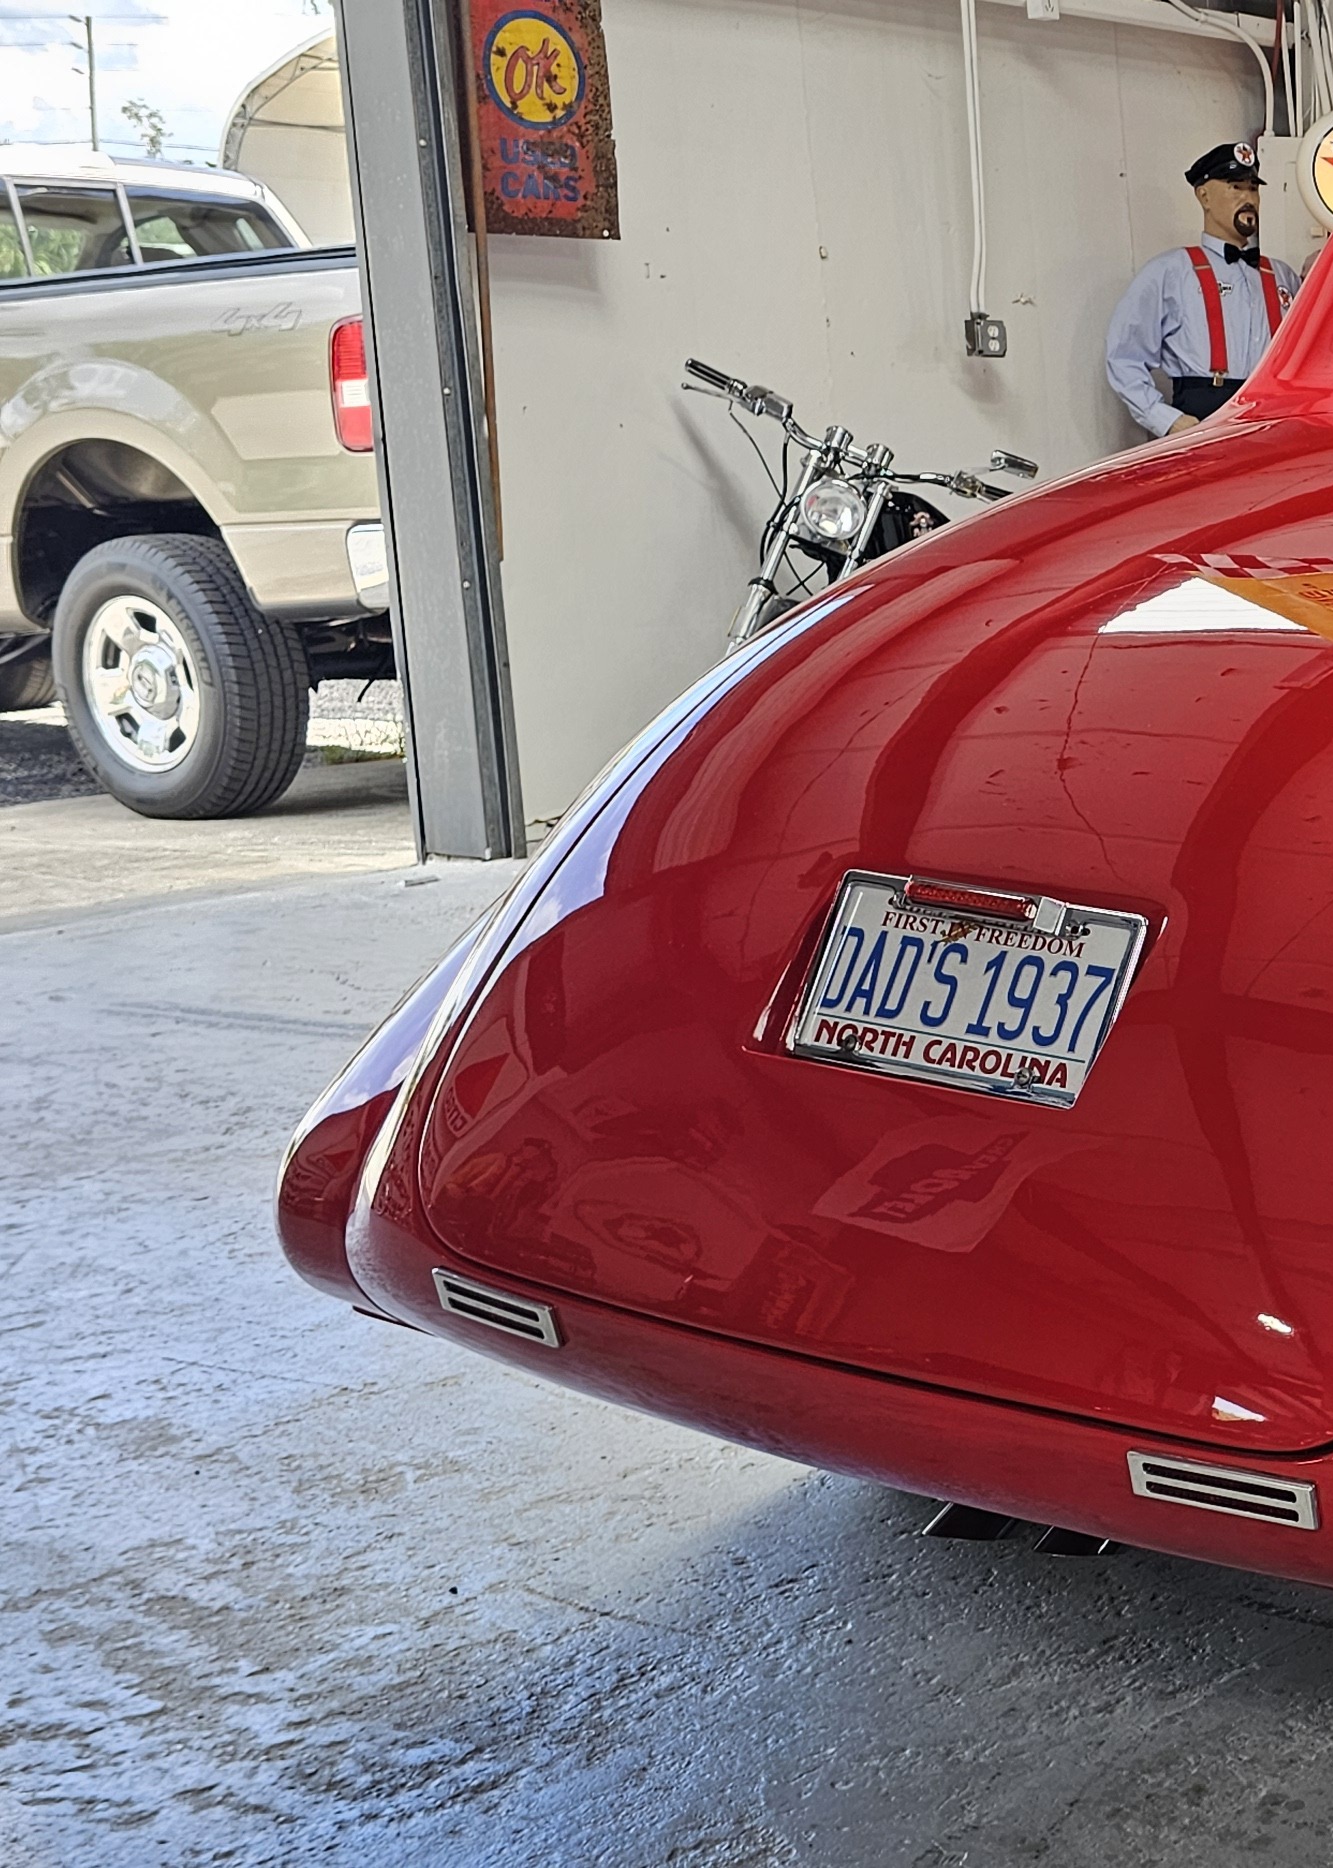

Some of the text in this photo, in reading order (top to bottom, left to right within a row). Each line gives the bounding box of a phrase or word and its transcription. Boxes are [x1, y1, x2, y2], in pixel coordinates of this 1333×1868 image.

[504, 37, 567, 101] OK
[501, 171, 580, 202] CARS
[881, 910, 946, 935] FIRST
[974, 926, 1086, 958] FREEDOM
[820, 924, 1116, 1053] DAD'S 1937
[813, 1018, 1069, 1089] NORTH CAROLINA
